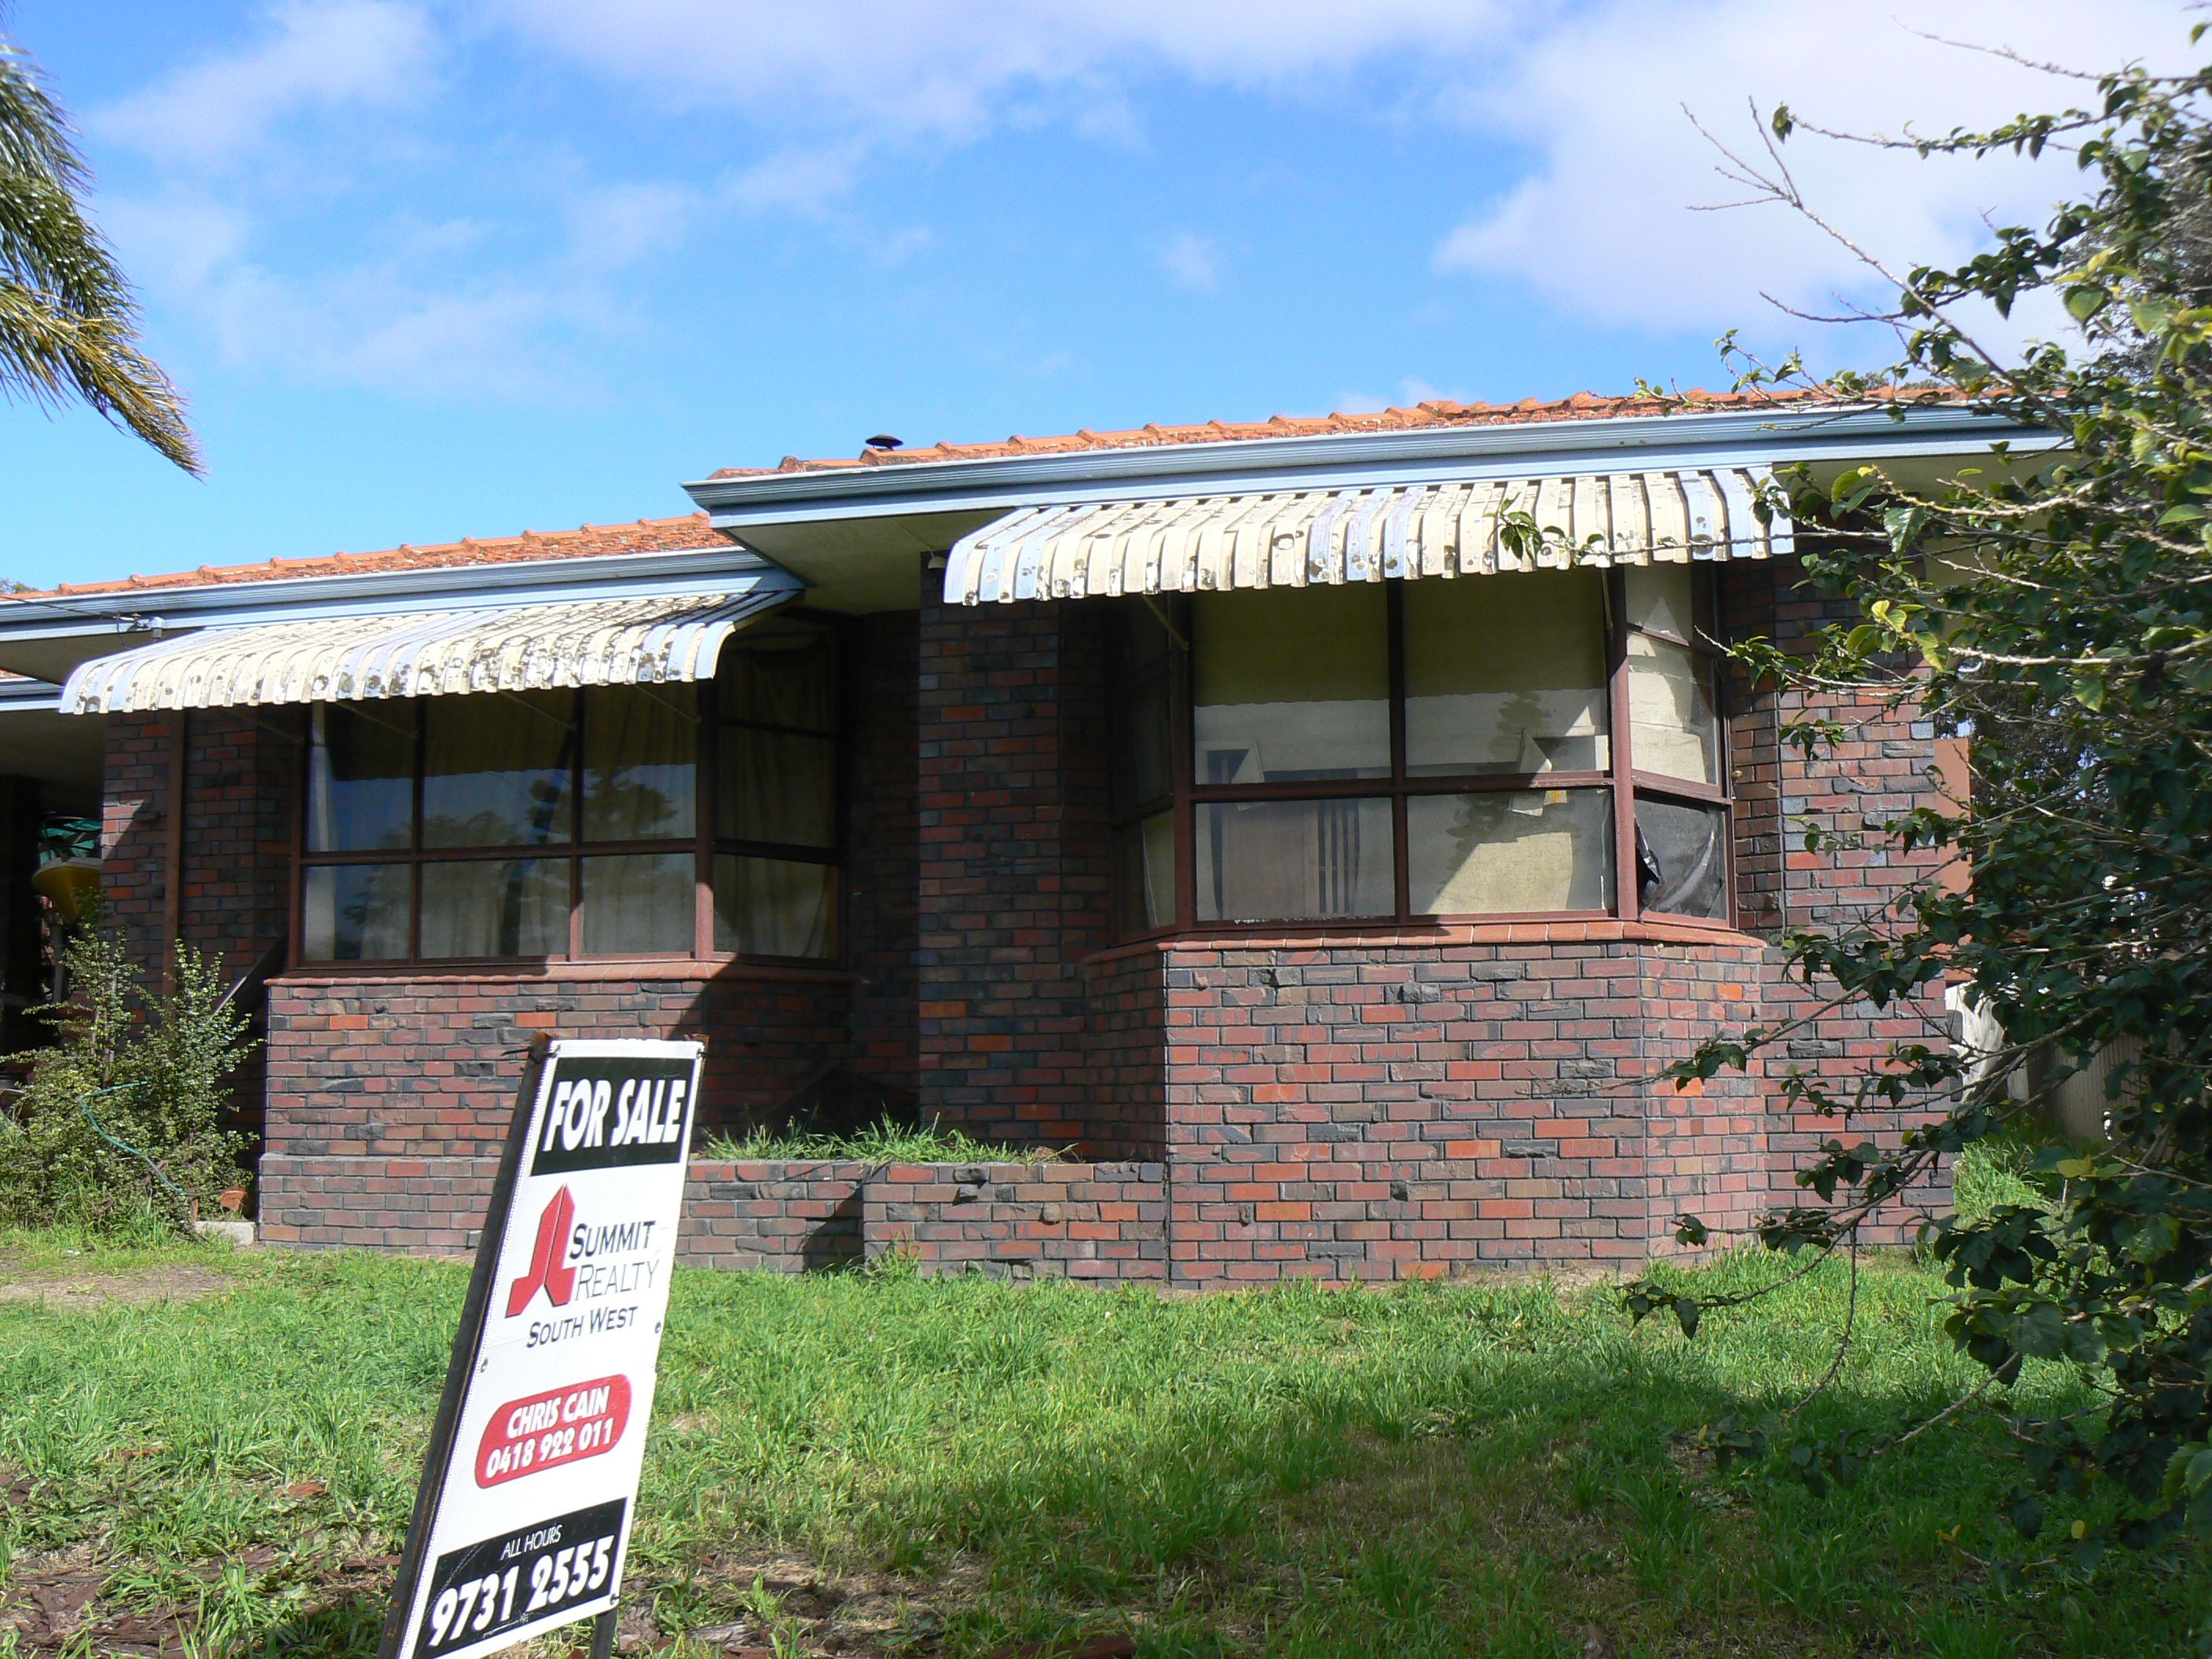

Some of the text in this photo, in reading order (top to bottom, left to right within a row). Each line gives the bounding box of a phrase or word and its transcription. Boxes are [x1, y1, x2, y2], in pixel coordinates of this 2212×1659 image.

[542, 1079, 686, 1151] FOR SALE
[569, 1221, 656, 1259] SUMMIT
[574, 1260, 660, 1301] REALTY
[526, 1306, 638, 1348] SOUTH WEST
[507, 1386, 610, 1438] CHRIS CAIN
[485, 1417, 613, 1478] 0418 922 011
[499, 1524, 563, 1561] ALL HOURS
[428, 1535, 614, 1646] 9731 2555
